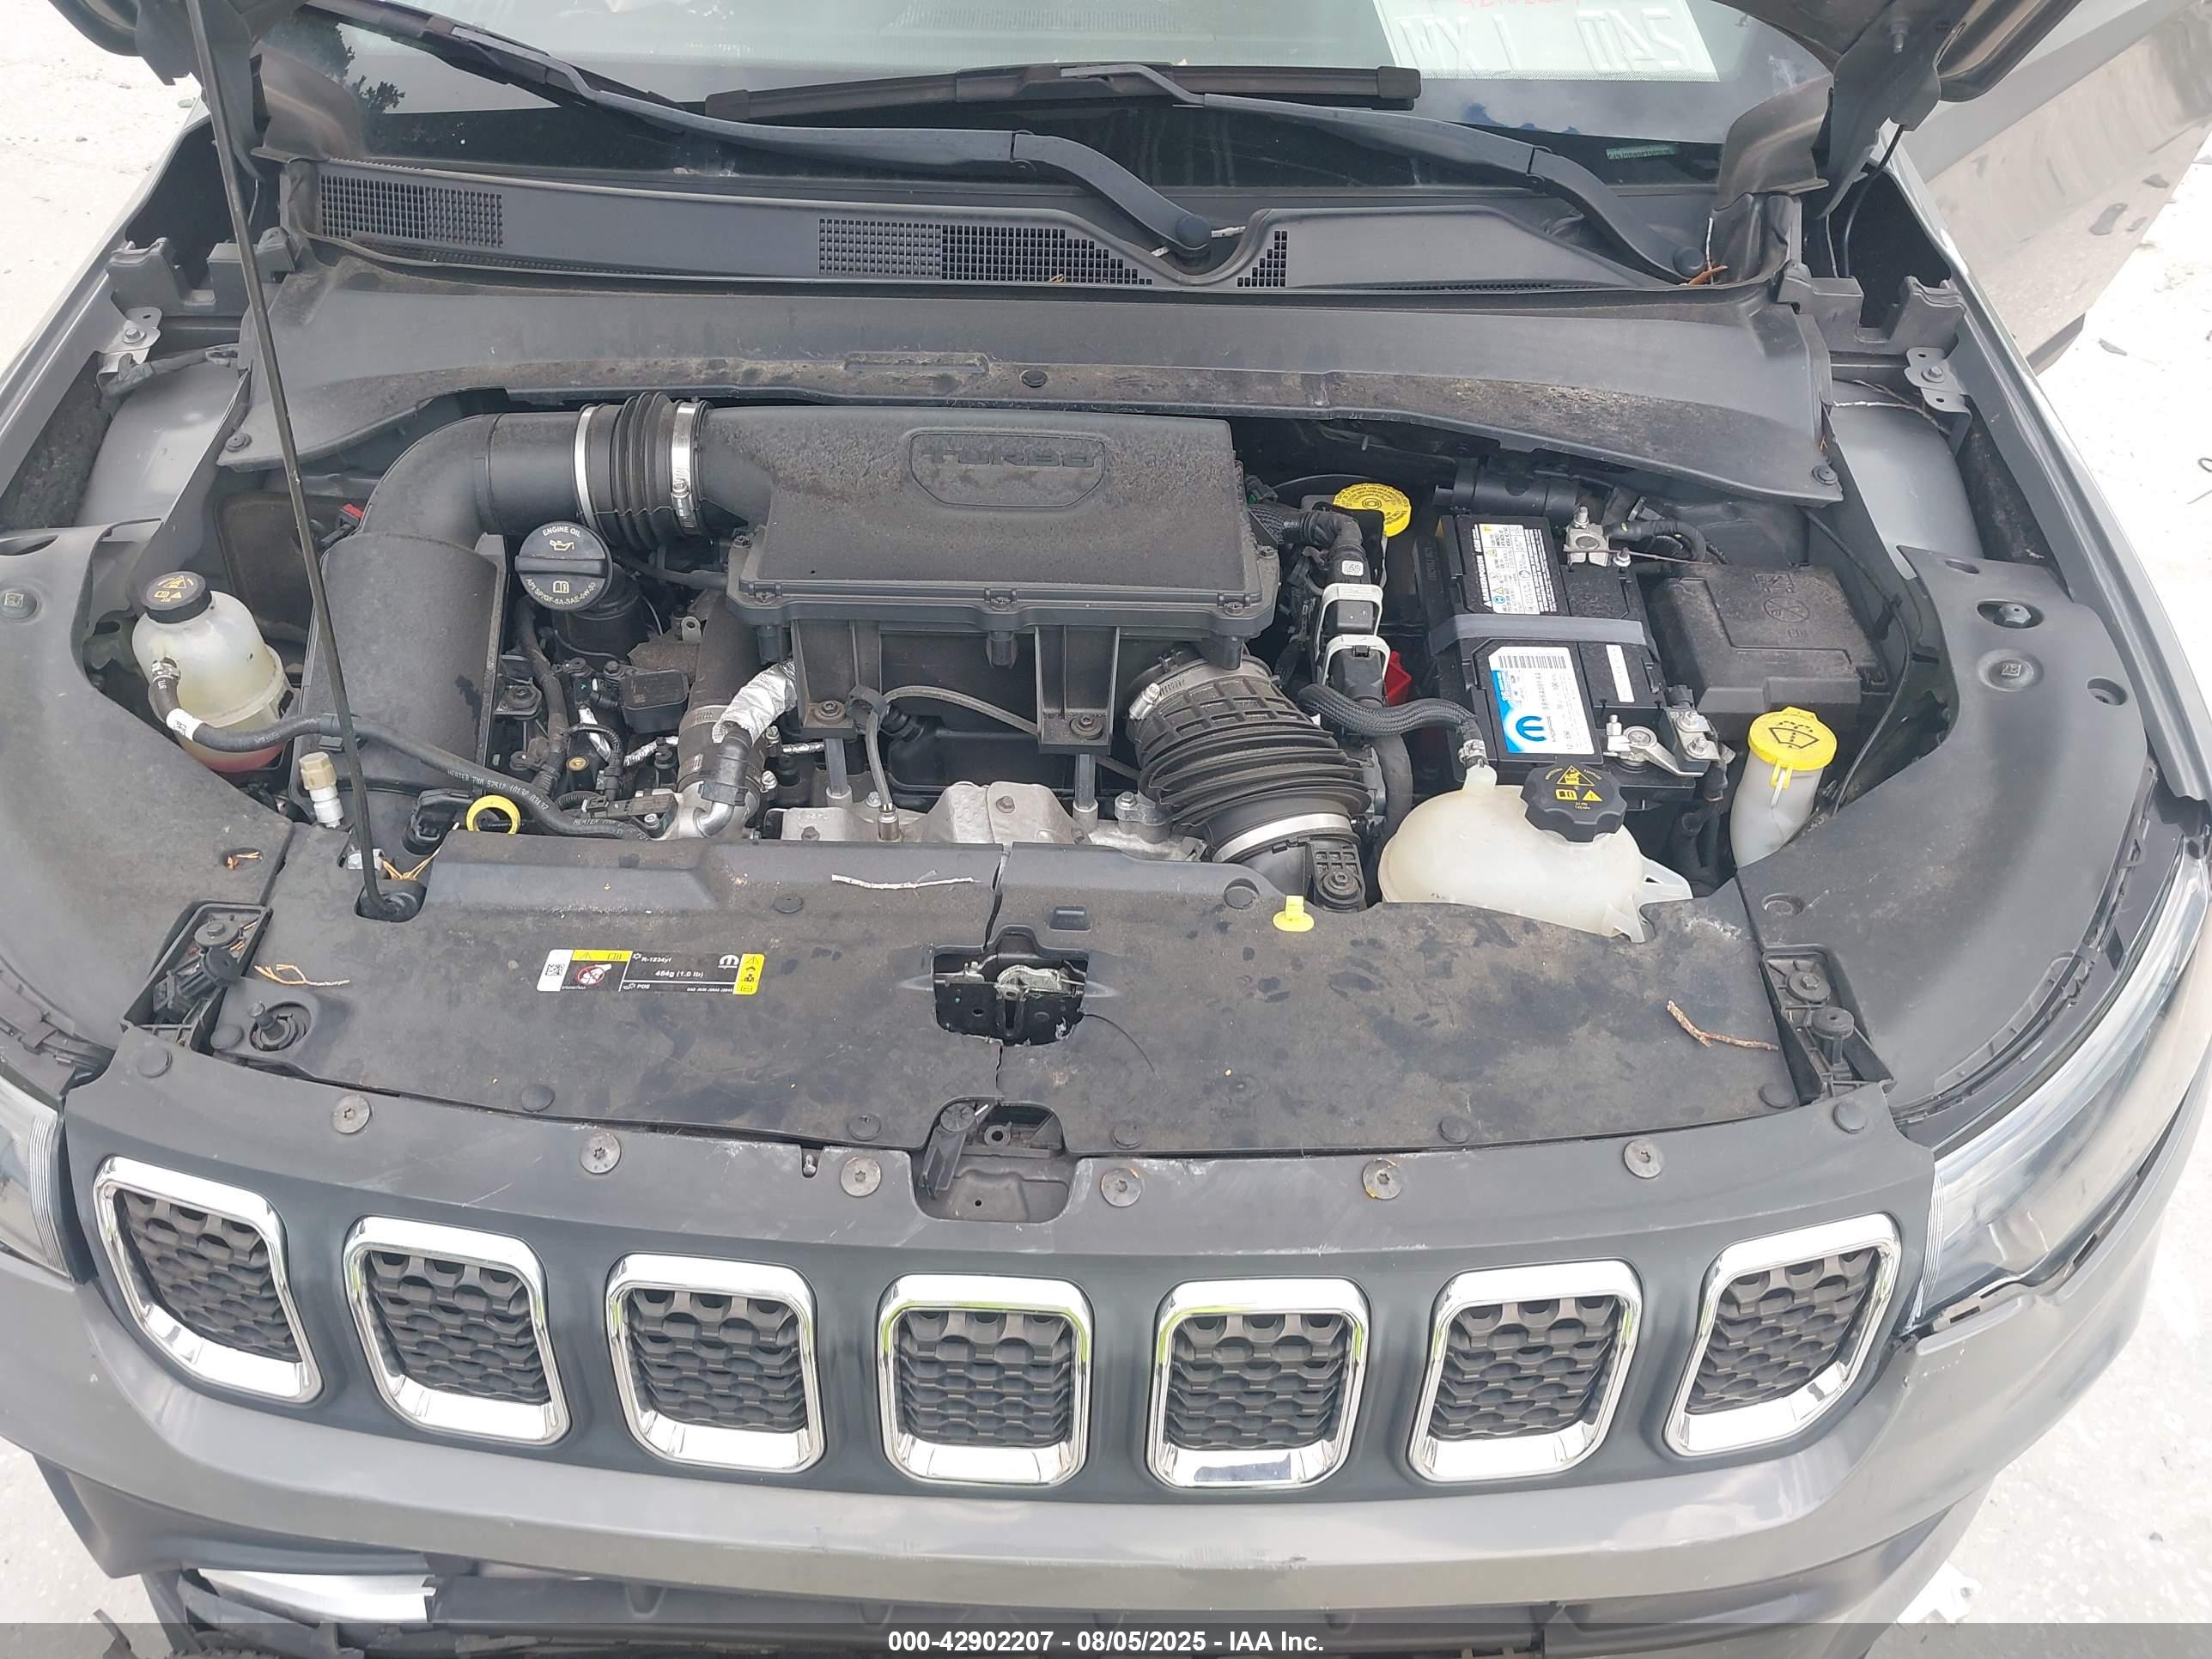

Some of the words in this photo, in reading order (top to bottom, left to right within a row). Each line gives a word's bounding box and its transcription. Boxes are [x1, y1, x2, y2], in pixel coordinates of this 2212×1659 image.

[542, 526, 569, 537] ENGINE
[569, 527, 581, 538] OIL
[447, 769, 469, 781] HEATER
